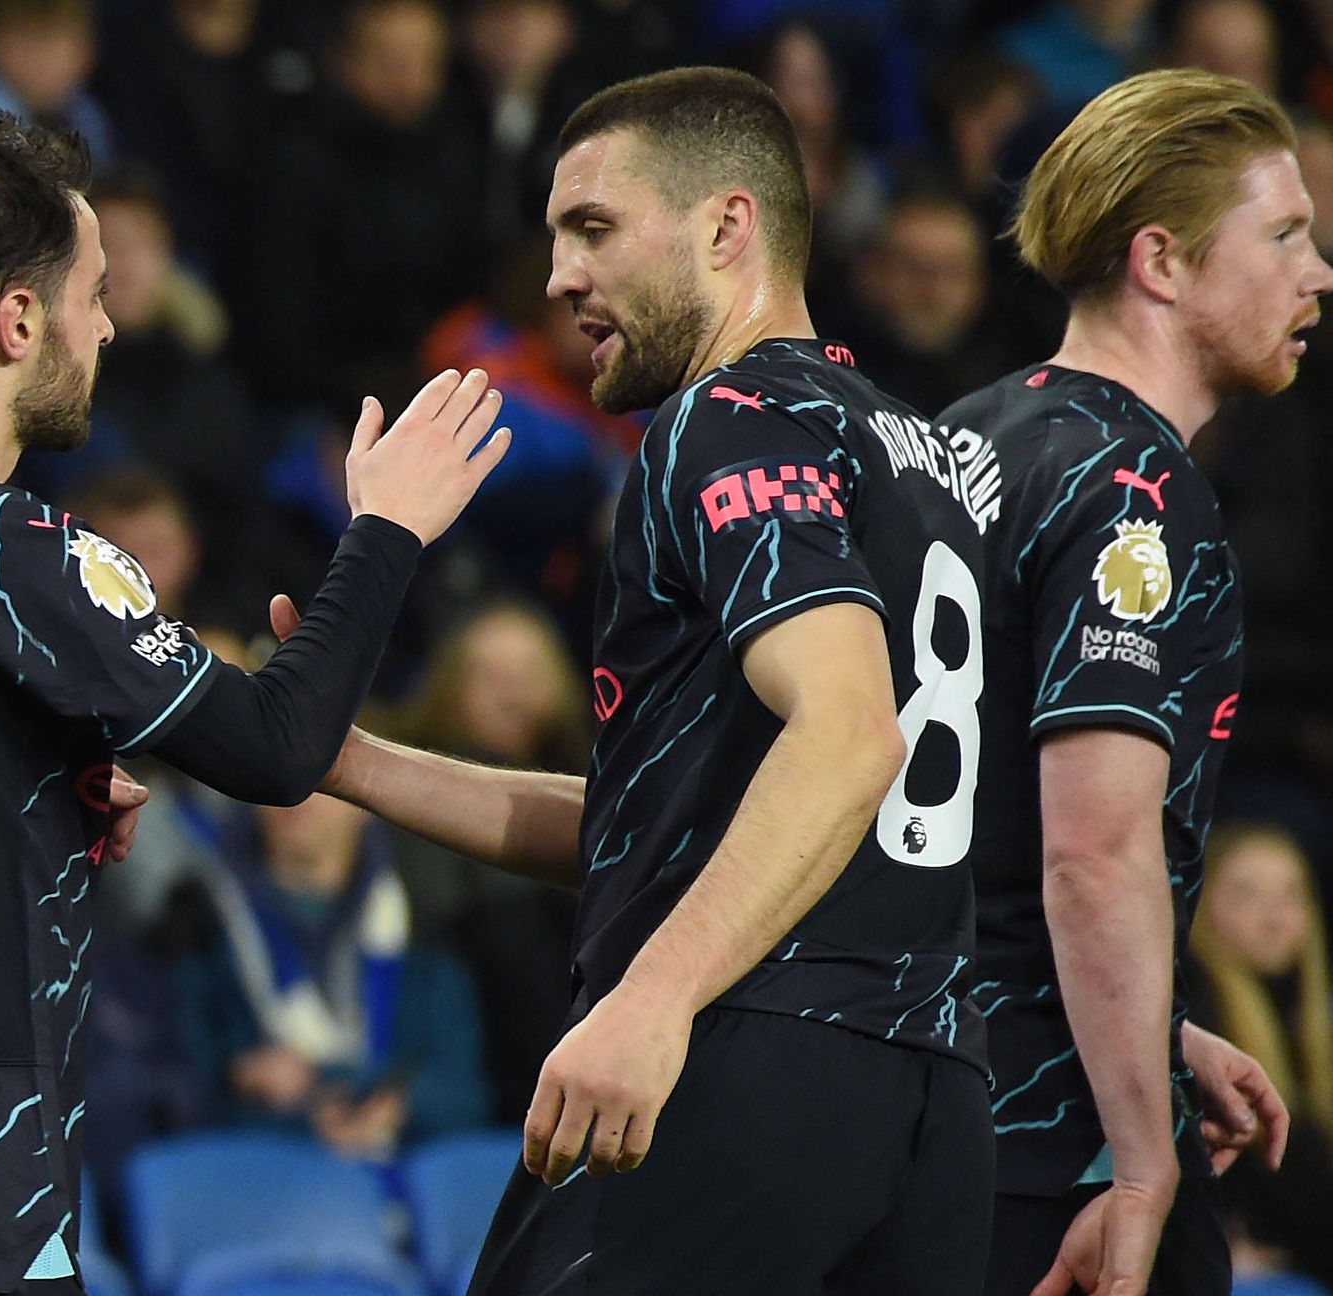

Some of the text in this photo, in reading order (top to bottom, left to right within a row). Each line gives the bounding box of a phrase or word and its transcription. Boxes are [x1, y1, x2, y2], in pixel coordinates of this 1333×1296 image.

[1079, 641, 1112, 661] for
[1081, 624, 1158, 658] No room
[876, 540, 984, 868] 8
